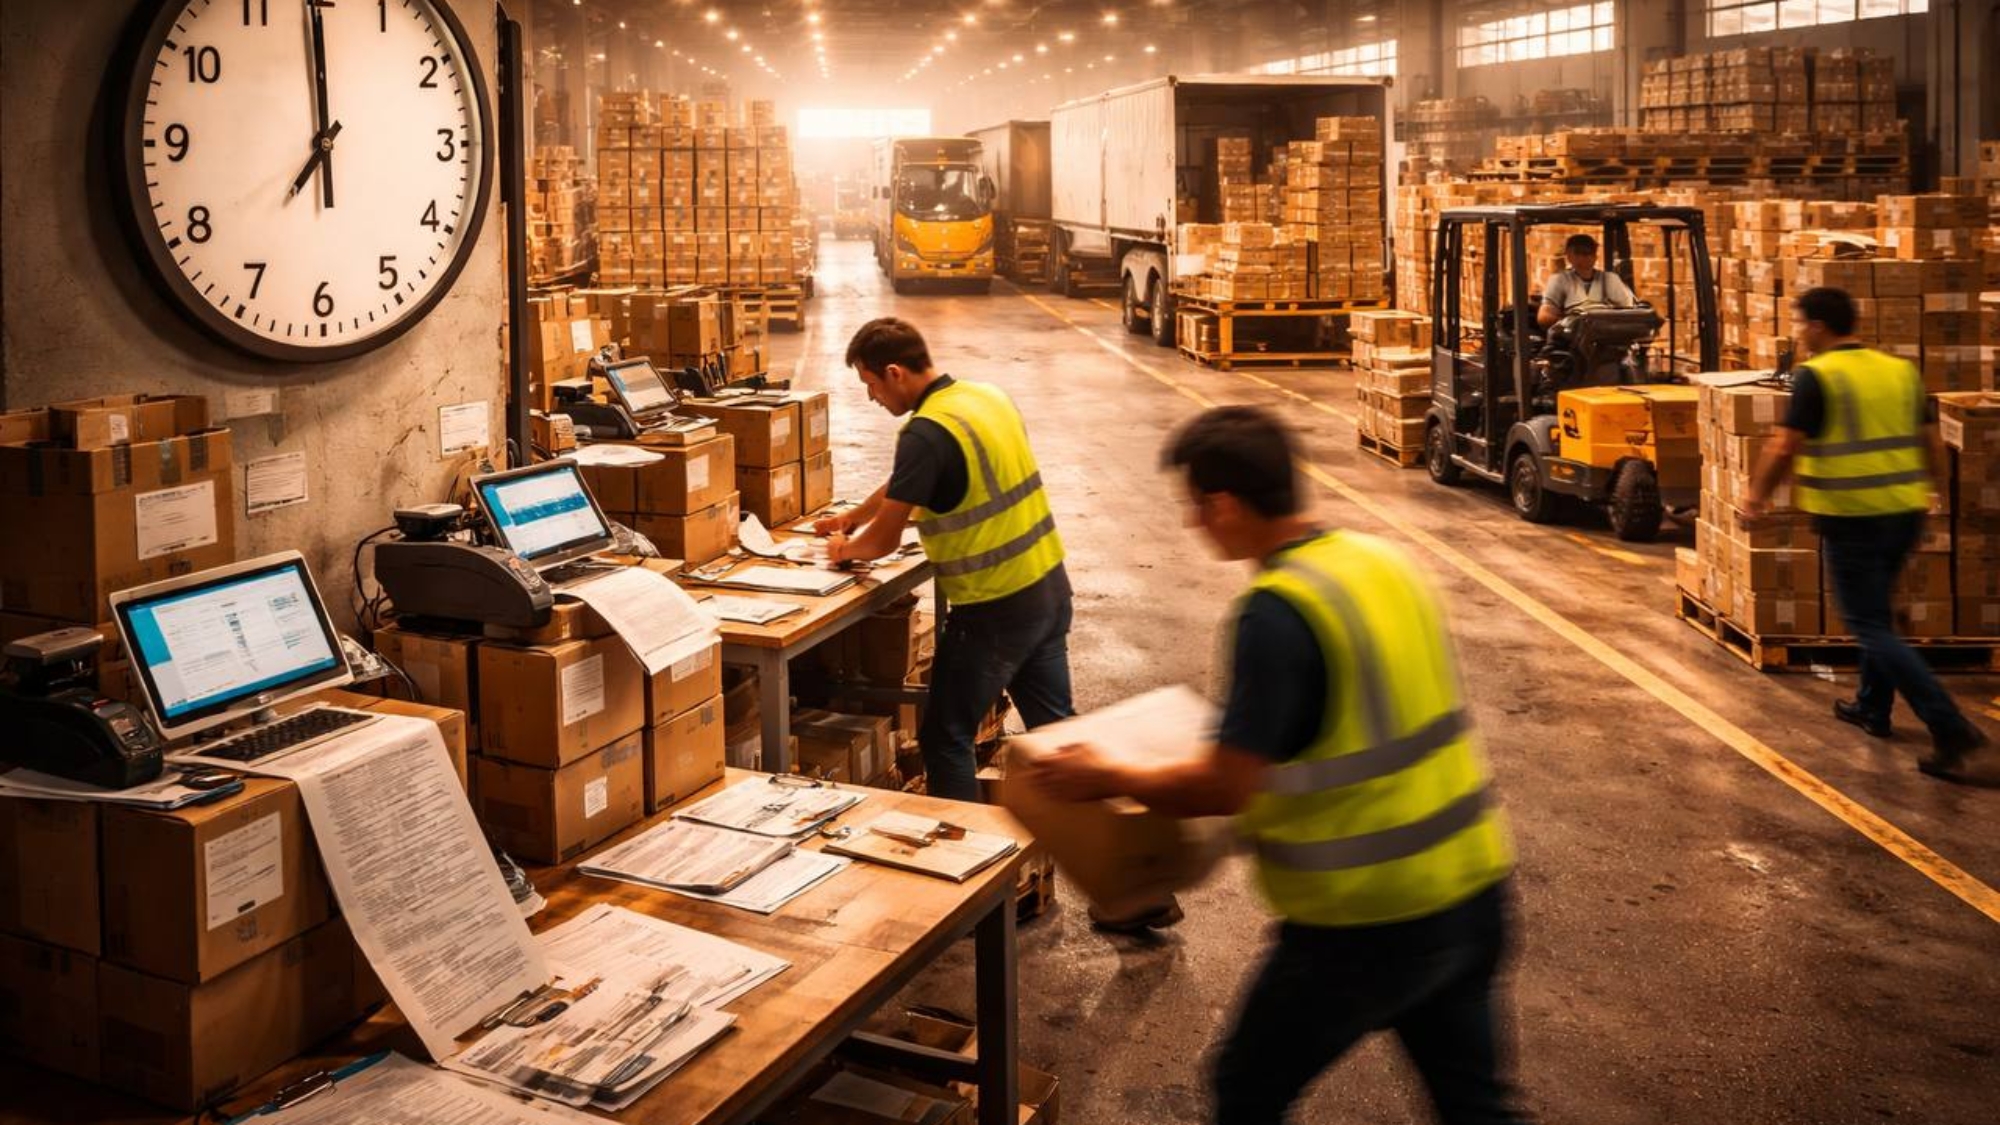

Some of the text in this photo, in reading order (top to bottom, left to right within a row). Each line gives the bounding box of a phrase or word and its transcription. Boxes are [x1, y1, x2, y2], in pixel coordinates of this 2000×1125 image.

[243, 0, 268, 26] 11
[377, 0, 386, 33] 1
[182, 45, 221, 84] 10
[419, 55, 438, 89] 2
[163, 122, 190, 163] 9
[436, 128, 455, 162] 3
[186, 205, 213, 244] 8
[419, 199, 440, 233] 4
[243, 262, 267, 300] 7
[379, 255, 399, 291] 5
[313, 281, 334, 318] 6
